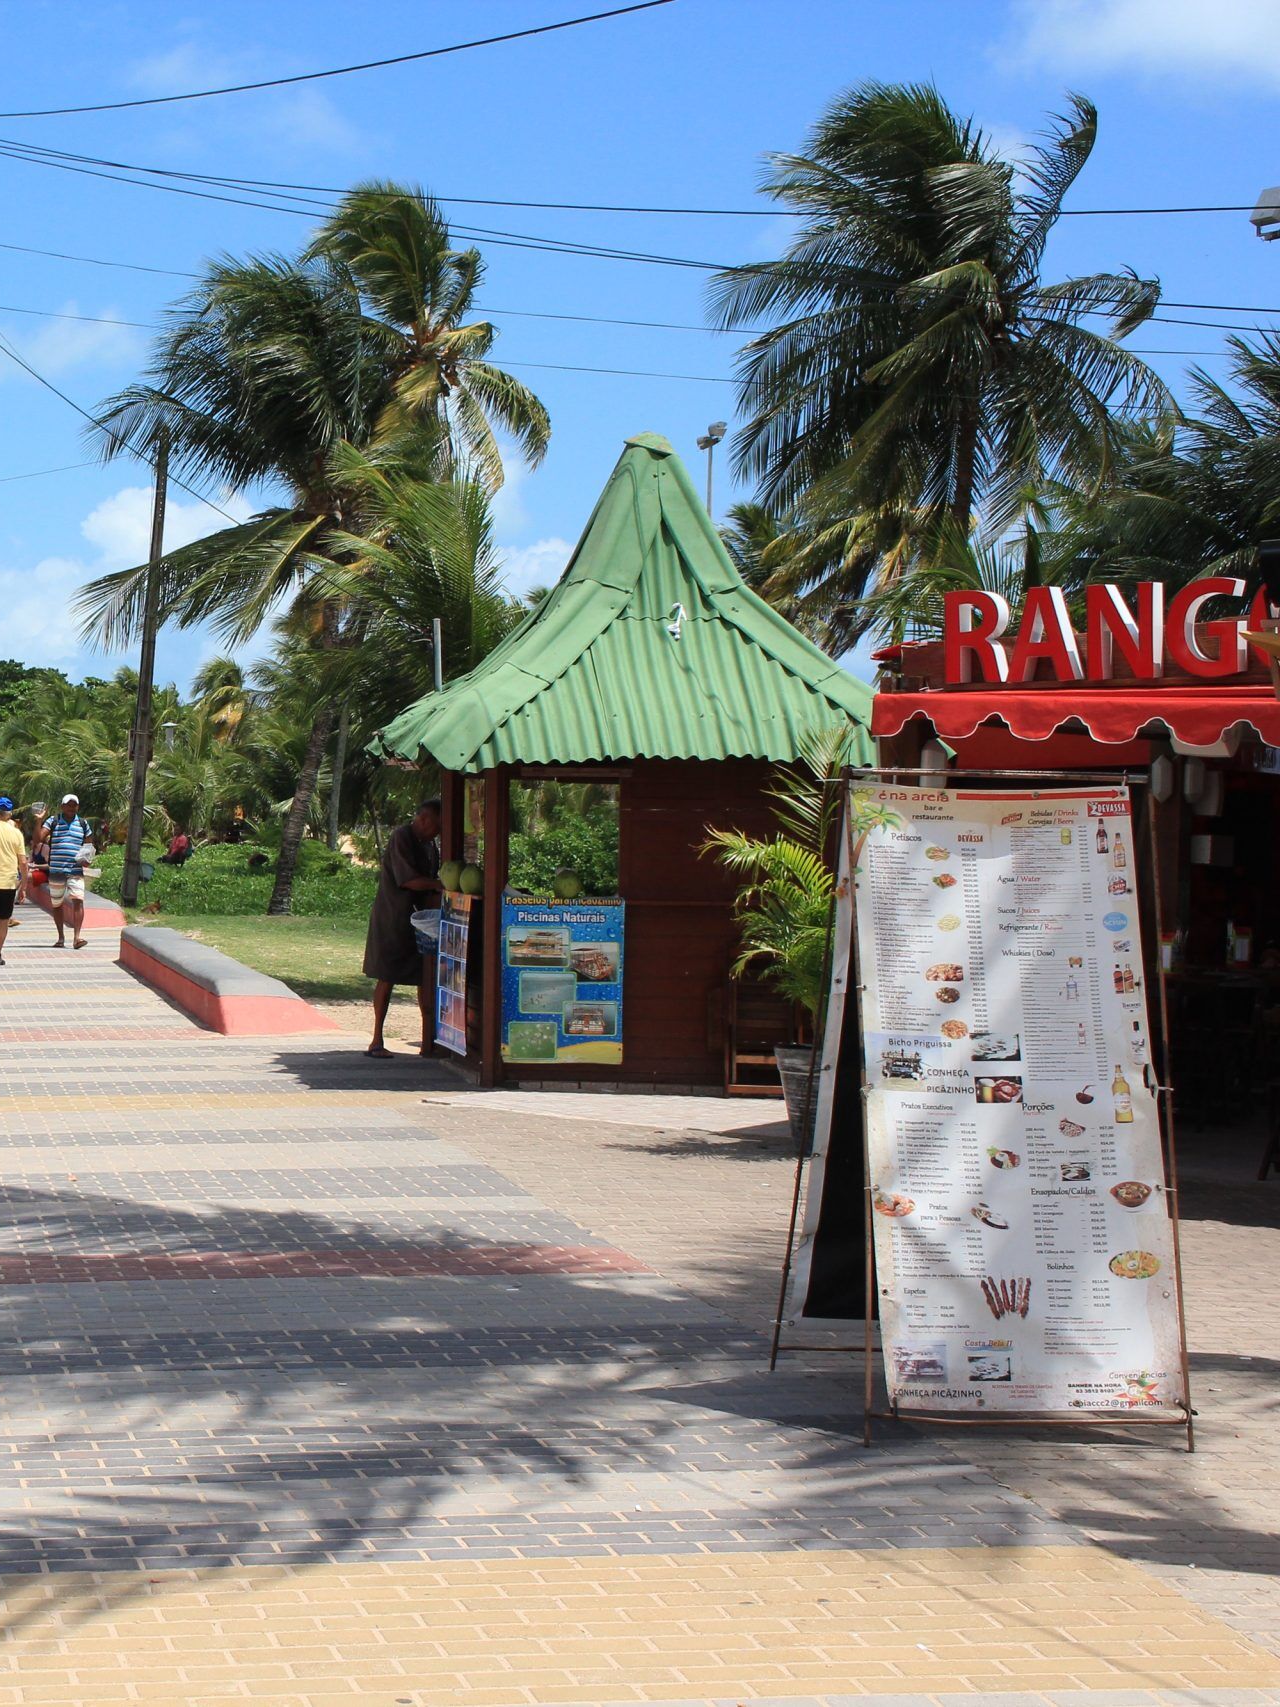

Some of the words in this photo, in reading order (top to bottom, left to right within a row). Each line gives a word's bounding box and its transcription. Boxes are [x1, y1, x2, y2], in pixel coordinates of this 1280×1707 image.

[878, 790, 887, 801] é
[890, 791, 908, 801] na
[911, 790, 950, 802] areia
[1098, 803, 1126, 813] DEVASSA
[1030, 809, 1053, 817] Bebidas
[1058, 809, 1079, 817] Drinks
[1028, 818, 1052, 827] Cervejas
[891, 833, 922, 842] Petiscos
[957, 834, 984, 843] DEVASSA
[1020, 875, 1041, 883] Water
[518, 911, 560, 922] Piscinas
[563, 911, 606, 923] Naturais
[999, 923, 1039, 932] Refrigerante
[1001, 949, 1031, 958] Whiskies
[888, 1038, 912, 1047] Bicho
[913, 1039, 952, 1049] Priguissa
[926, 1068, 969, 1078] CONHEÇA
[900, 1102, 921, 1110] Pratos
[922, 1103, 953, 1111] Executivos
[1021, 1102, 1055, 1112] Porções
[1031, 1187, 1096, 1198] Ensopados/Caldos
[929, 1203, 948, 1211] Pratos
[1047, 1262, 1075, 1270] Bolinhos
[903, 1287, 926, 1296] Espetos
[964, 1339, 986, 1347] Costa
[988, 1339, 1005, 1347] Bela
[1108, 1371, 1167, 1379] Conveniências
[893, 1389, 929, 1398] CONHEÇA
